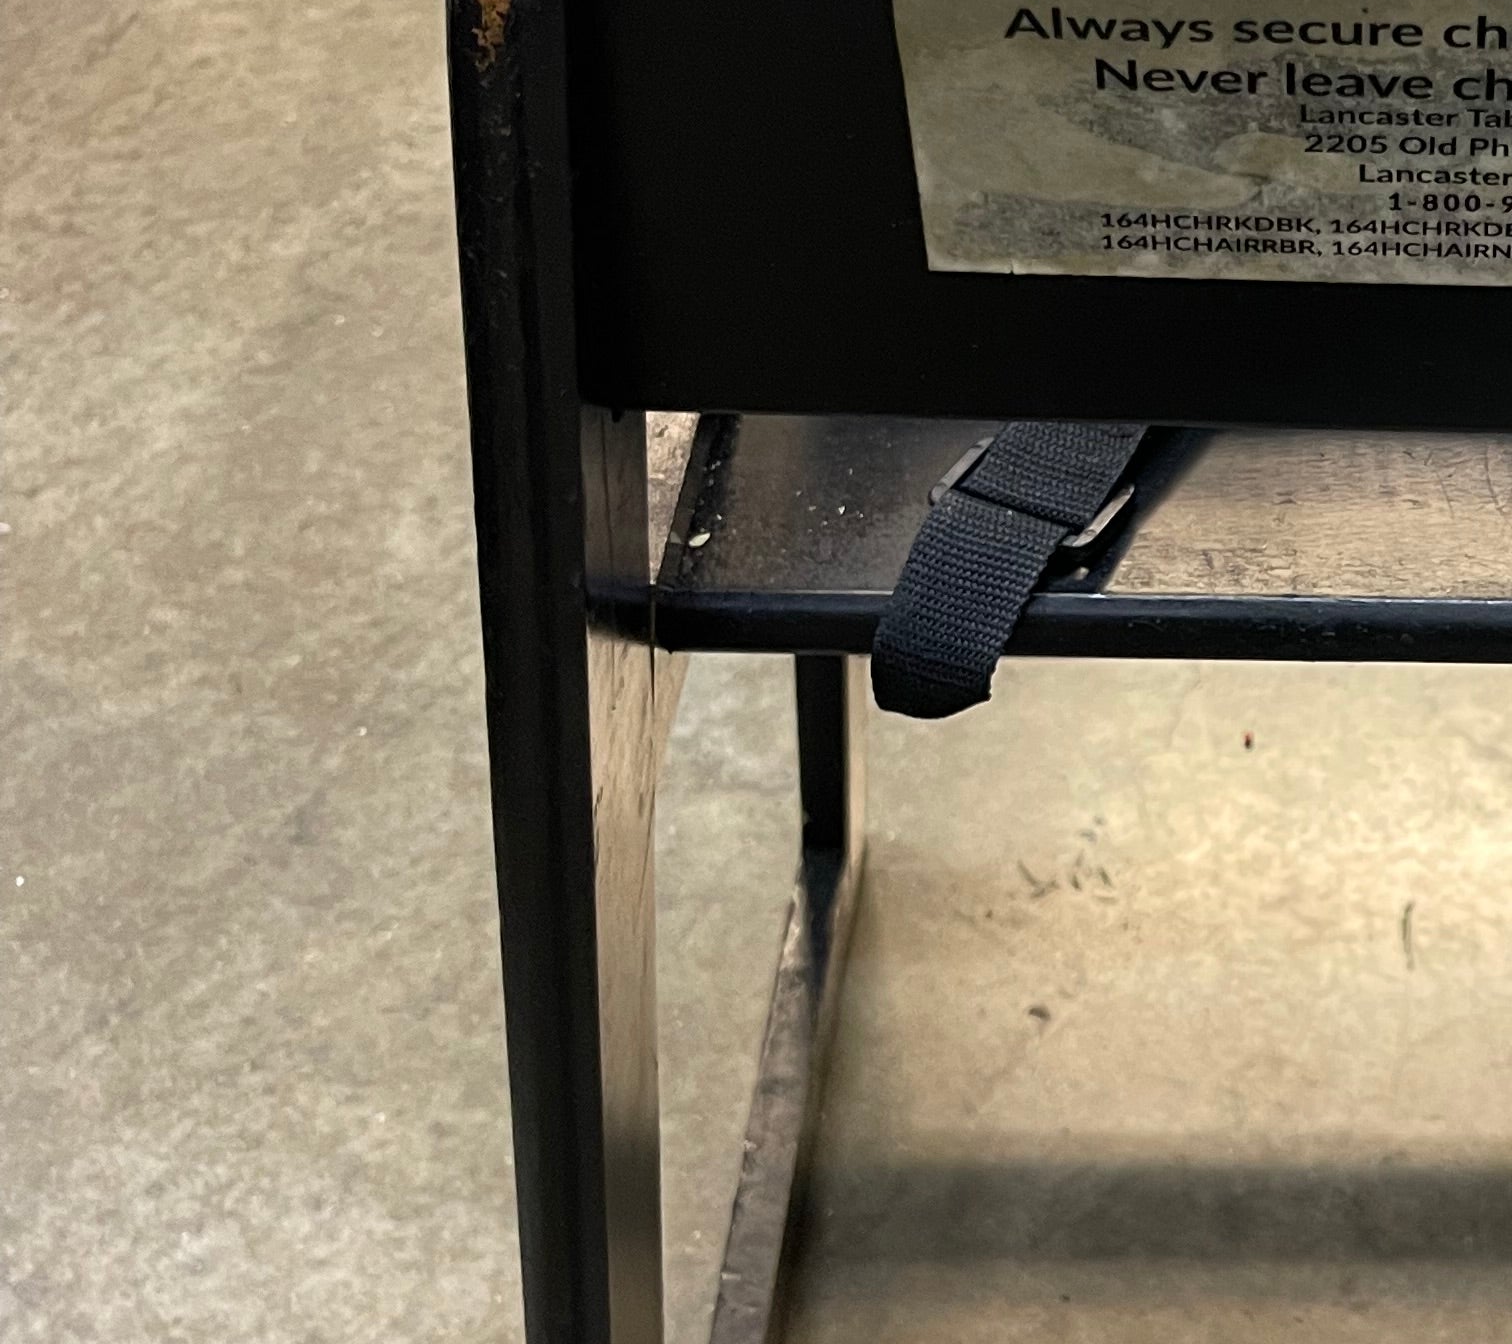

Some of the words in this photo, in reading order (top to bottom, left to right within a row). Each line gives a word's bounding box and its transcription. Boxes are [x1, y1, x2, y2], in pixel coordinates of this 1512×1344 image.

[1004, 7, 1214, 49] Always
[1233, 18, 1423, 47] secure
[1095, 58, 1267, 95] Never
[1285, 62, 1433, 99] leave
[1299, 105, 1458, 128] Lancaster
[1304, 134, 1388, 154] 2205
[1399, 135, 1457, 157] Old
[1100, 212, 1322, 235] 164HCHRKDBK,
[1101, 234, 1322, 256] 164HCHAIRRBR,
